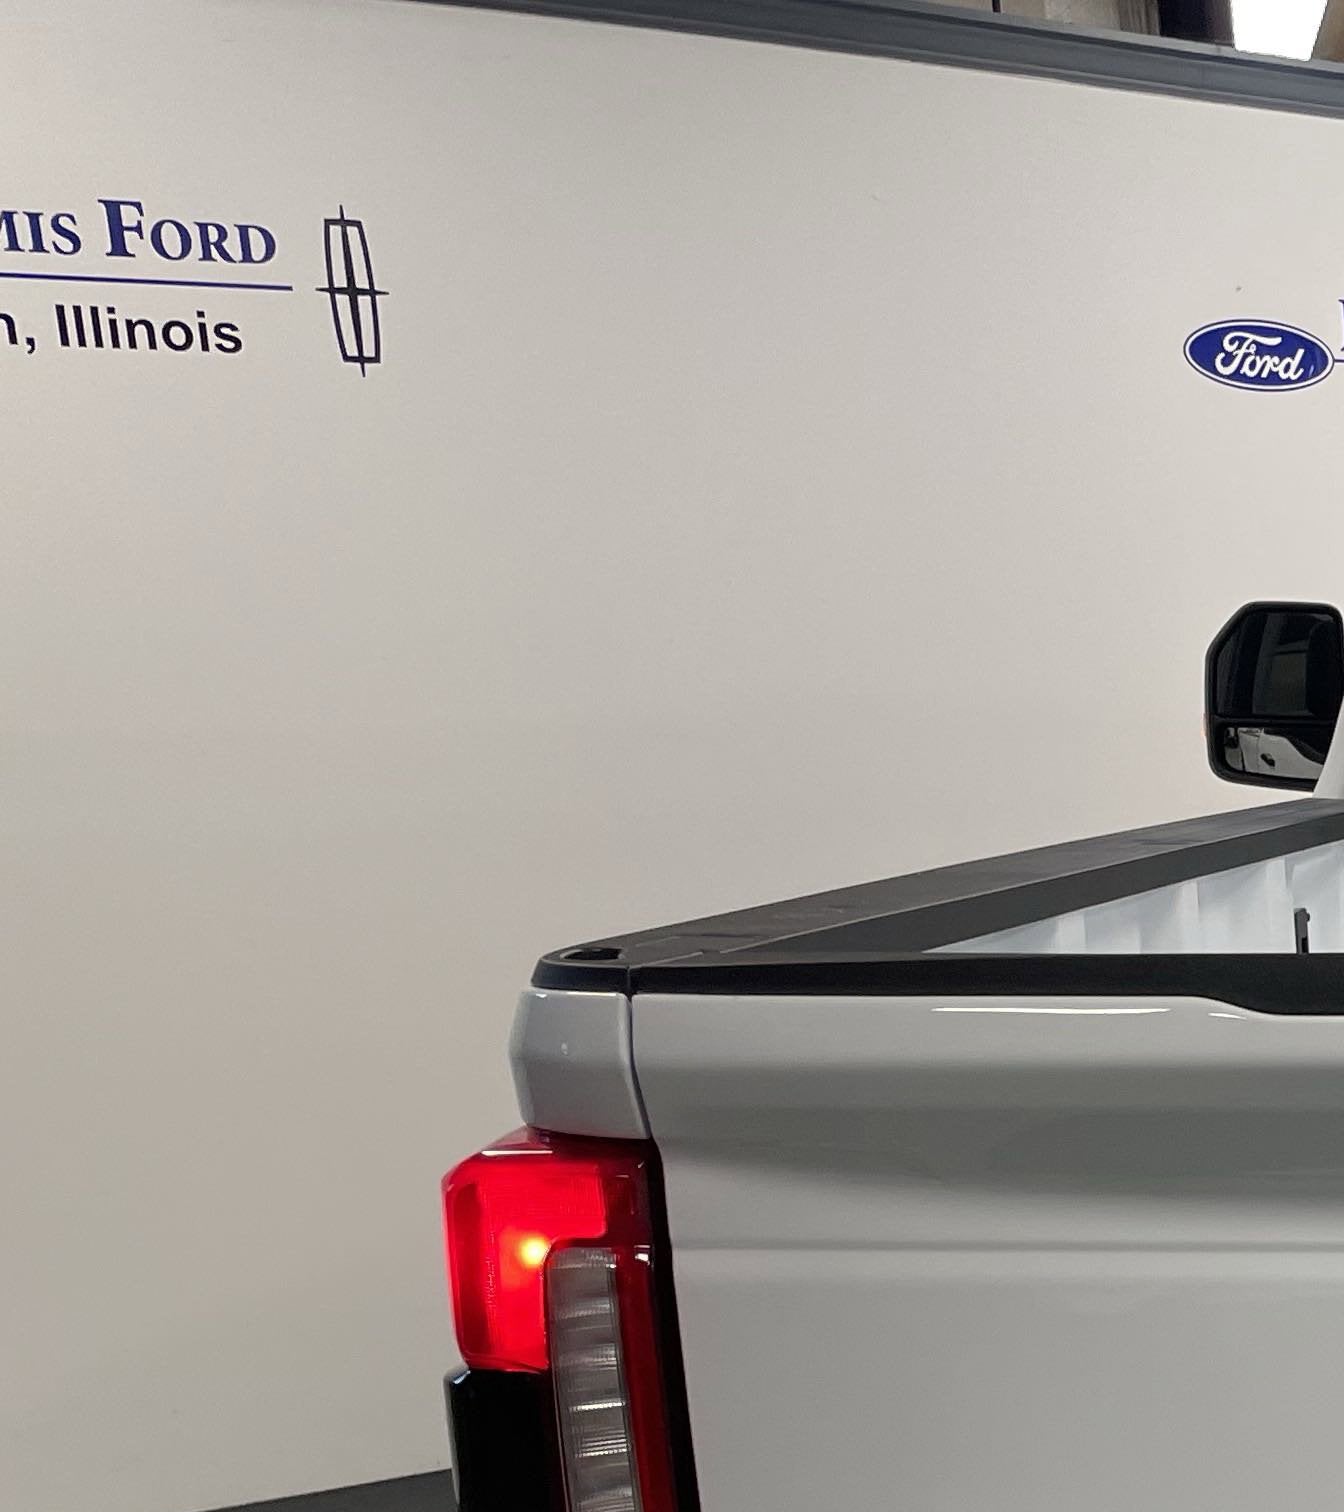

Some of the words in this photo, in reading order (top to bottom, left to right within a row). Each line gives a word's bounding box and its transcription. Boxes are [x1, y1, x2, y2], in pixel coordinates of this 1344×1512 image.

[97, 198, 277, 265] FORD
[55, 303, 243, 355] Illinois
[1214, 331, 1304, 381] Ford
